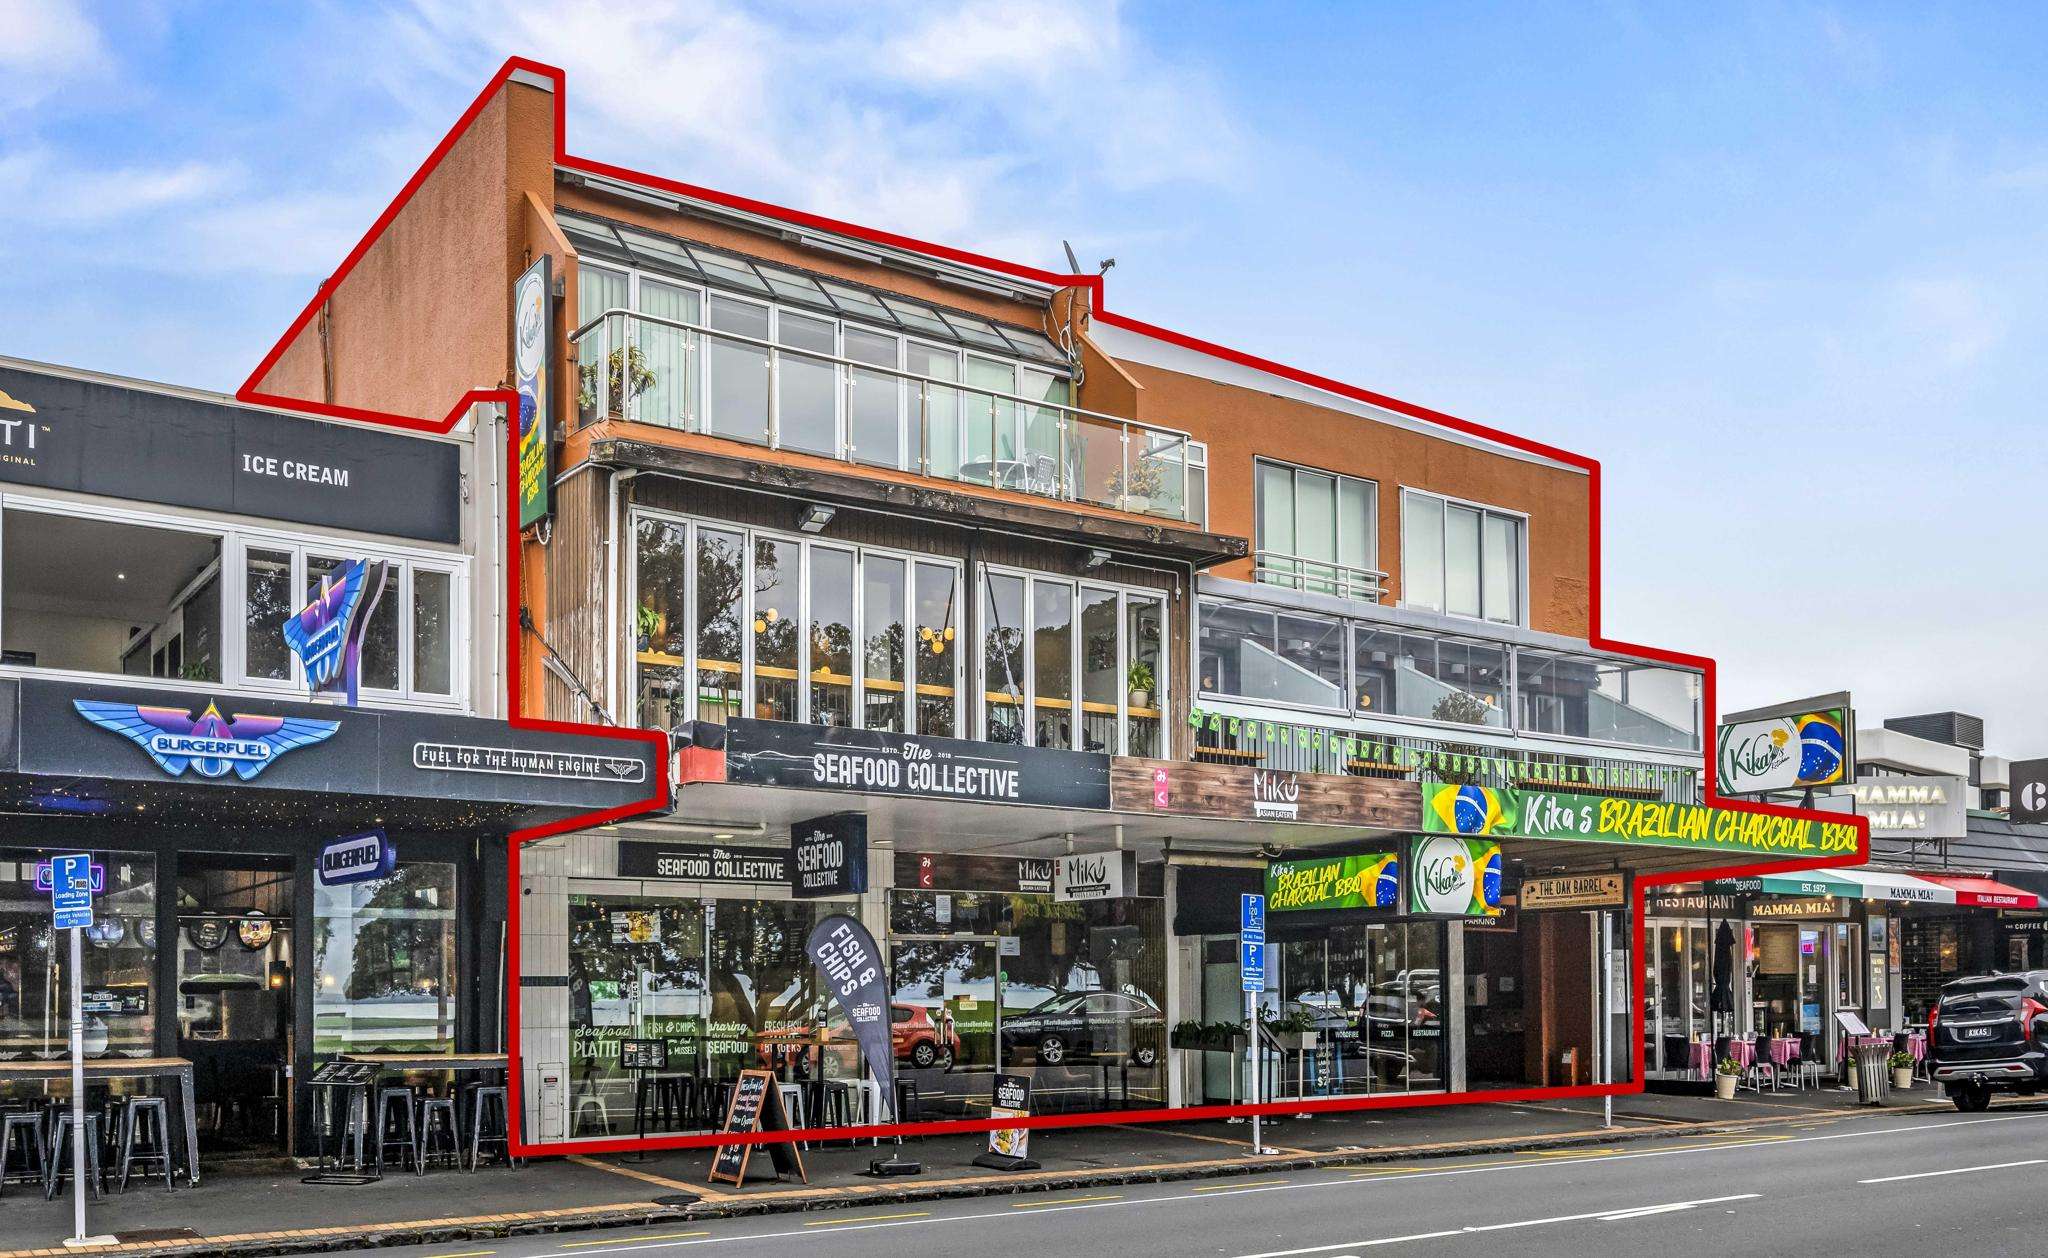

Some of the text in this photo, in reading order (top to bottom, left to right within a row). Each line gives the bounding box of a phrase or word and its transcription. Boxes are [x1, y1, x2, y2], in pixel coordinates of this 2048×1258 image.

[0, 454, 36, 466] GINAL
[242, 454, 350, 487] ICE CREAM
[157, 738, 267, 757] BURGERFUEL
[903, 742, 932, 761] The
[422, 750, 600, 774] FUEL FOR THE HUMAN ENGINE
[813, 753, 1019, 798] SEAFOOD COLLECTIVE
[1155, 771, 1167, 804] みく
[1850, 785, 1948, 804] MAMMA
[1259, 809, 1294, 819] ASIAN EATERY
[1867, 810, 1926, 829] MIA!
[1524, 794, 1858, 852] Kika's BRAZILIAN CHARCOAL BBQ
[712, 848, 731, 860] The
[798, 840, 843, 872] SEAFOOD
[65, 859, 76, 875] P
[657, 858, 784, 880] SEAFOOD COLLECTIVE
[921, 856, 931, 886] みく
[1271, 861, 1294, 877] Kika's
[68, 877, 74, 889] 5
[803, 870, 838, 888] COLLECTIVE
[1278, 862, 1341, 890] BRAZILIAN
[1270, 876, 1362, 909] CHARCOAL BBQ
[1540, 878, 1603, 895] THE OAK BARREL
[1735, 879, 1762, 891] SEAFOOD
[1801, 883, 1826, 893] EST. 1972
[1890, 887, 1934, 900] MAMMA MIA!
[1993, 896, 2018, 904] RESTAURANT
[1249, 897, 1256, 907] P
[1752, 902, 1835, 916] MAMMA MIA!
[2014, 922, 2041, 930] COFFEE
[831, 923, 876, 987] FISH &
[1249, 945, 1256, 956] P
[816, 942, 858, 996] CHIPS
[1251, 957, 1255, 965] 5
[852, 1006, 881, 1018] SEAFOOD
[575, 1024, 632, 1040] Seafood
[665, 1021, 675, 1033] &
[573, 1040, 621, 1058] PLATTE
[674, 1046, 697, 1055] MUSSELS
[708, 1041, 749, 1054] SEAFOOD
[998, 1087, 1025, 1101] SEAFOOD
[1000, 1100, 1021, 1109] COLLECTIVE
